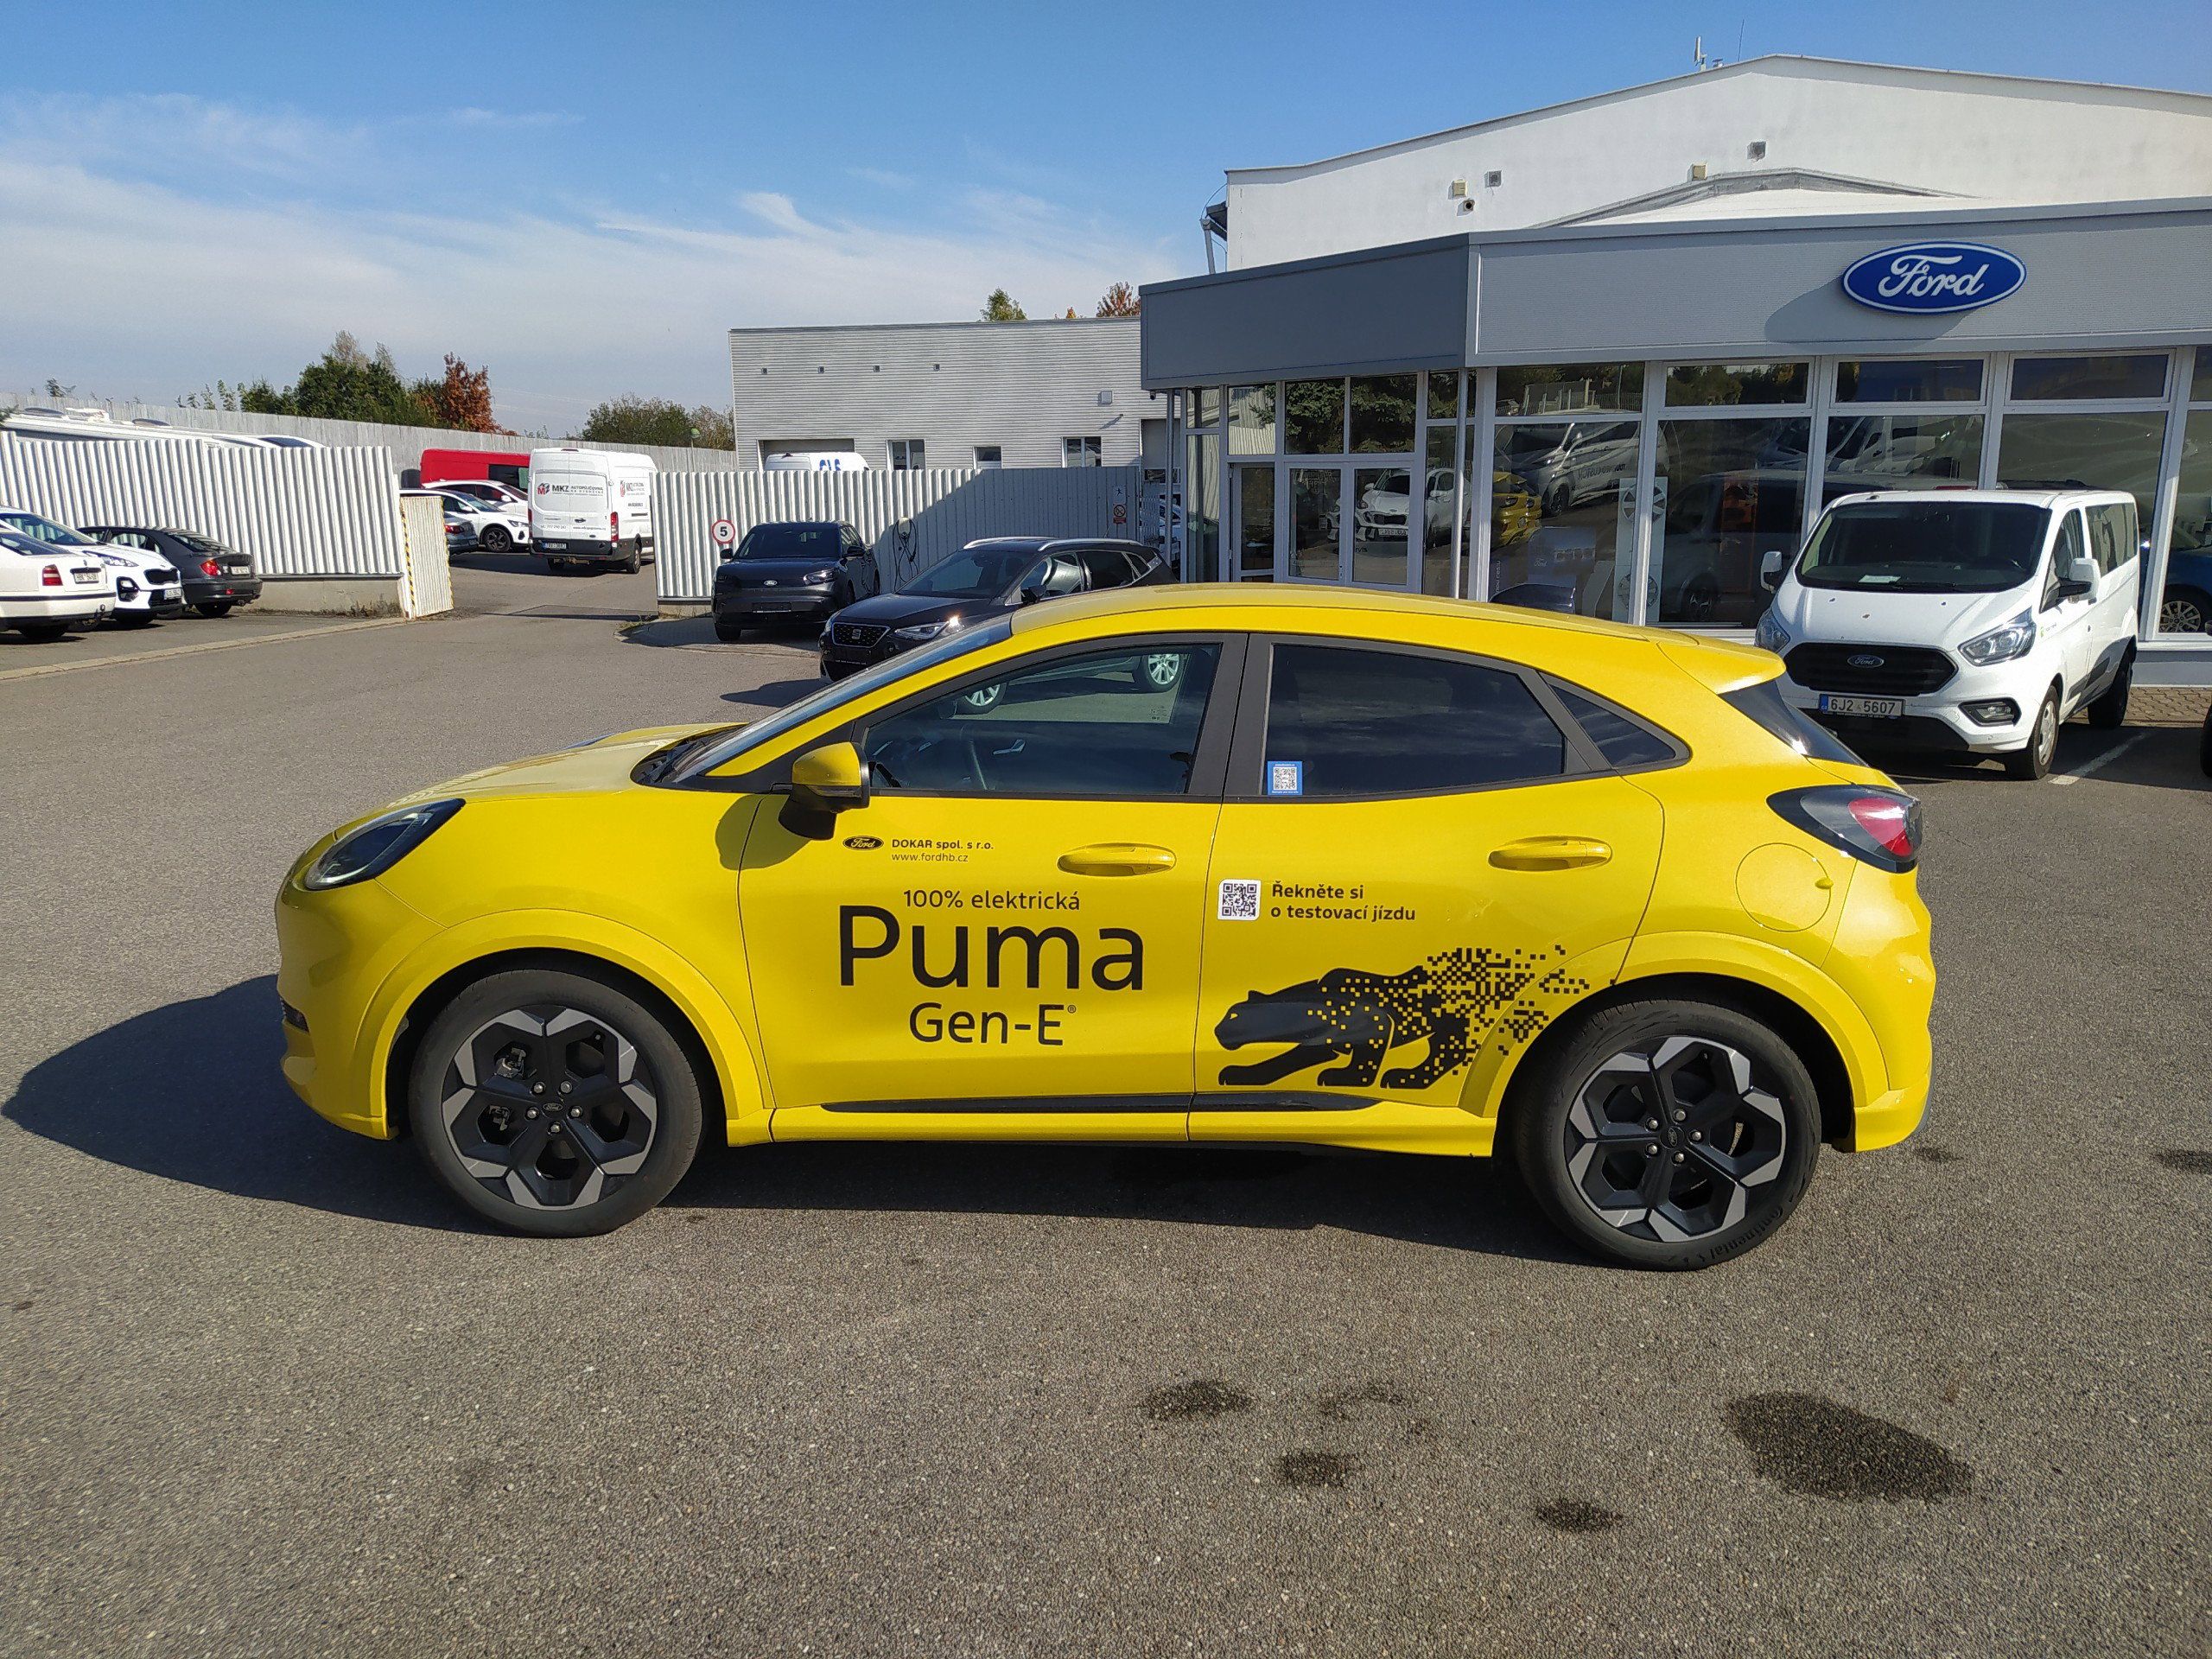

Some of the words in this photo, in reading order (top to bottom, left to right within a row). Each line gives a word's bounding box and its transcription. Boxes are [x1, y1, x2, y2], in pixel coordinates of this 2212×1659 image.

[1878, 254, 1990, 298] Ford
[720, 526, 728, 537] 5
[1854, 657, 1874, 665] Ford
[1831, 698, 1854, 712] 6J2
[1864, 701, 1896, 715] 5607
[892, 839, 932, 849] DOKAR
[936, 840, 963, 850] spol.
[976, 841, 995, 850] r.o.
[891, 852, 969, 862] www.fordhb.cz
[1272, 880, 1344, 899] Řekněte
[1350, 885, 1364, 899] si
[903, 889, 964, 908] 100%
[971, 890, 1080, 911] elektrická
[1270, 907, 1281, 918] o
[1287, 905, 1369, 920] testovací
[1371, 906, 1416, 923] jízdu
[839, 905, 1144, 991] Puma
